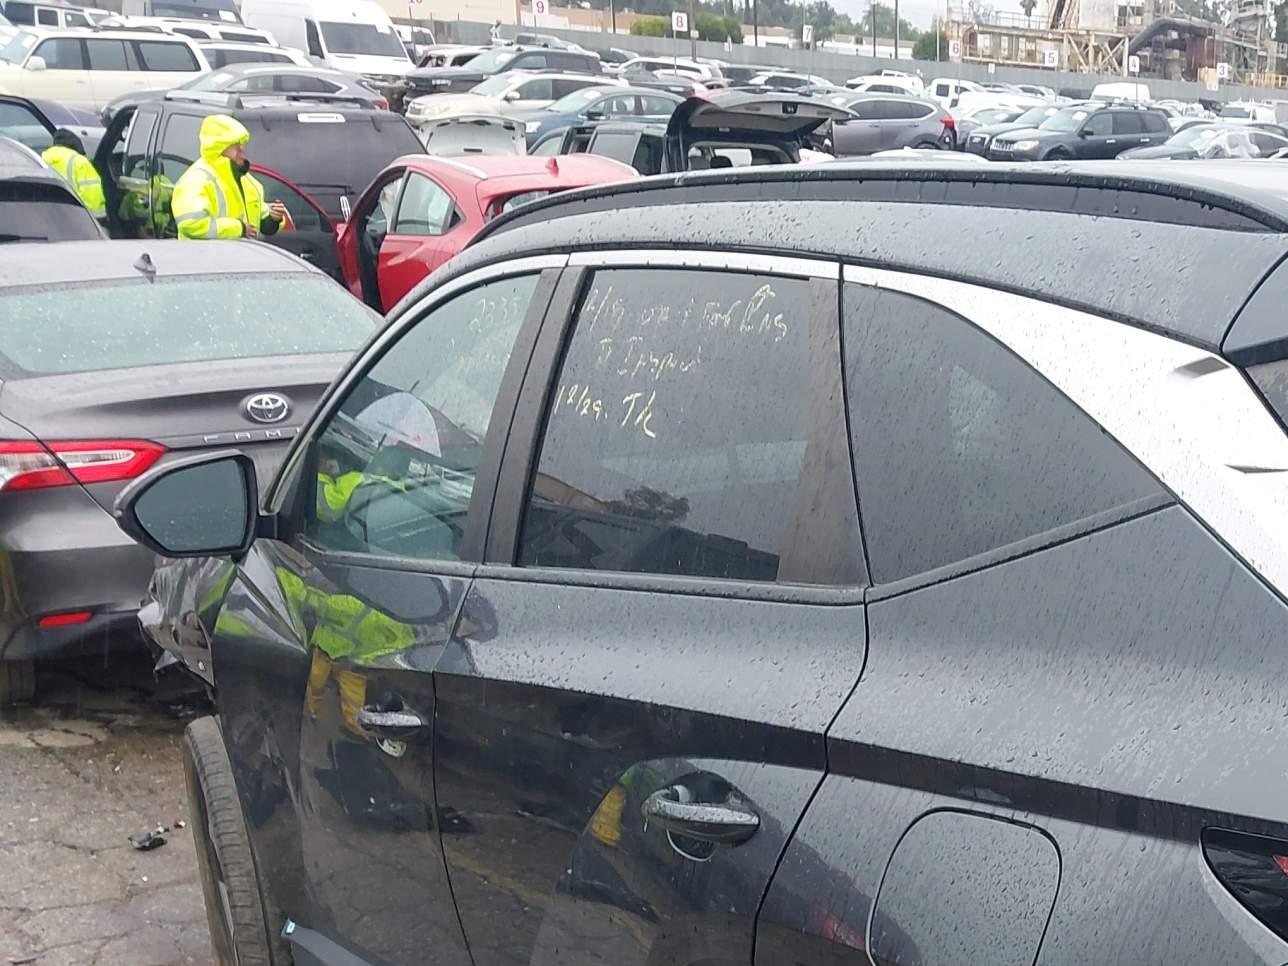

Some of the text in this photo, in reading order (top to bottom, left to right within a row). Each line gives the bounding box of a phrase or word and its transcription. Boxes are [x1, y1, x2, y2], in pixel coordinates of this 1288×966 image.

[536, 1, 545, 13] 9
[676, 15, 684, 28] 8
[952, 43, 960, 54] 6
[1048, 52, 1055, 63] 5
